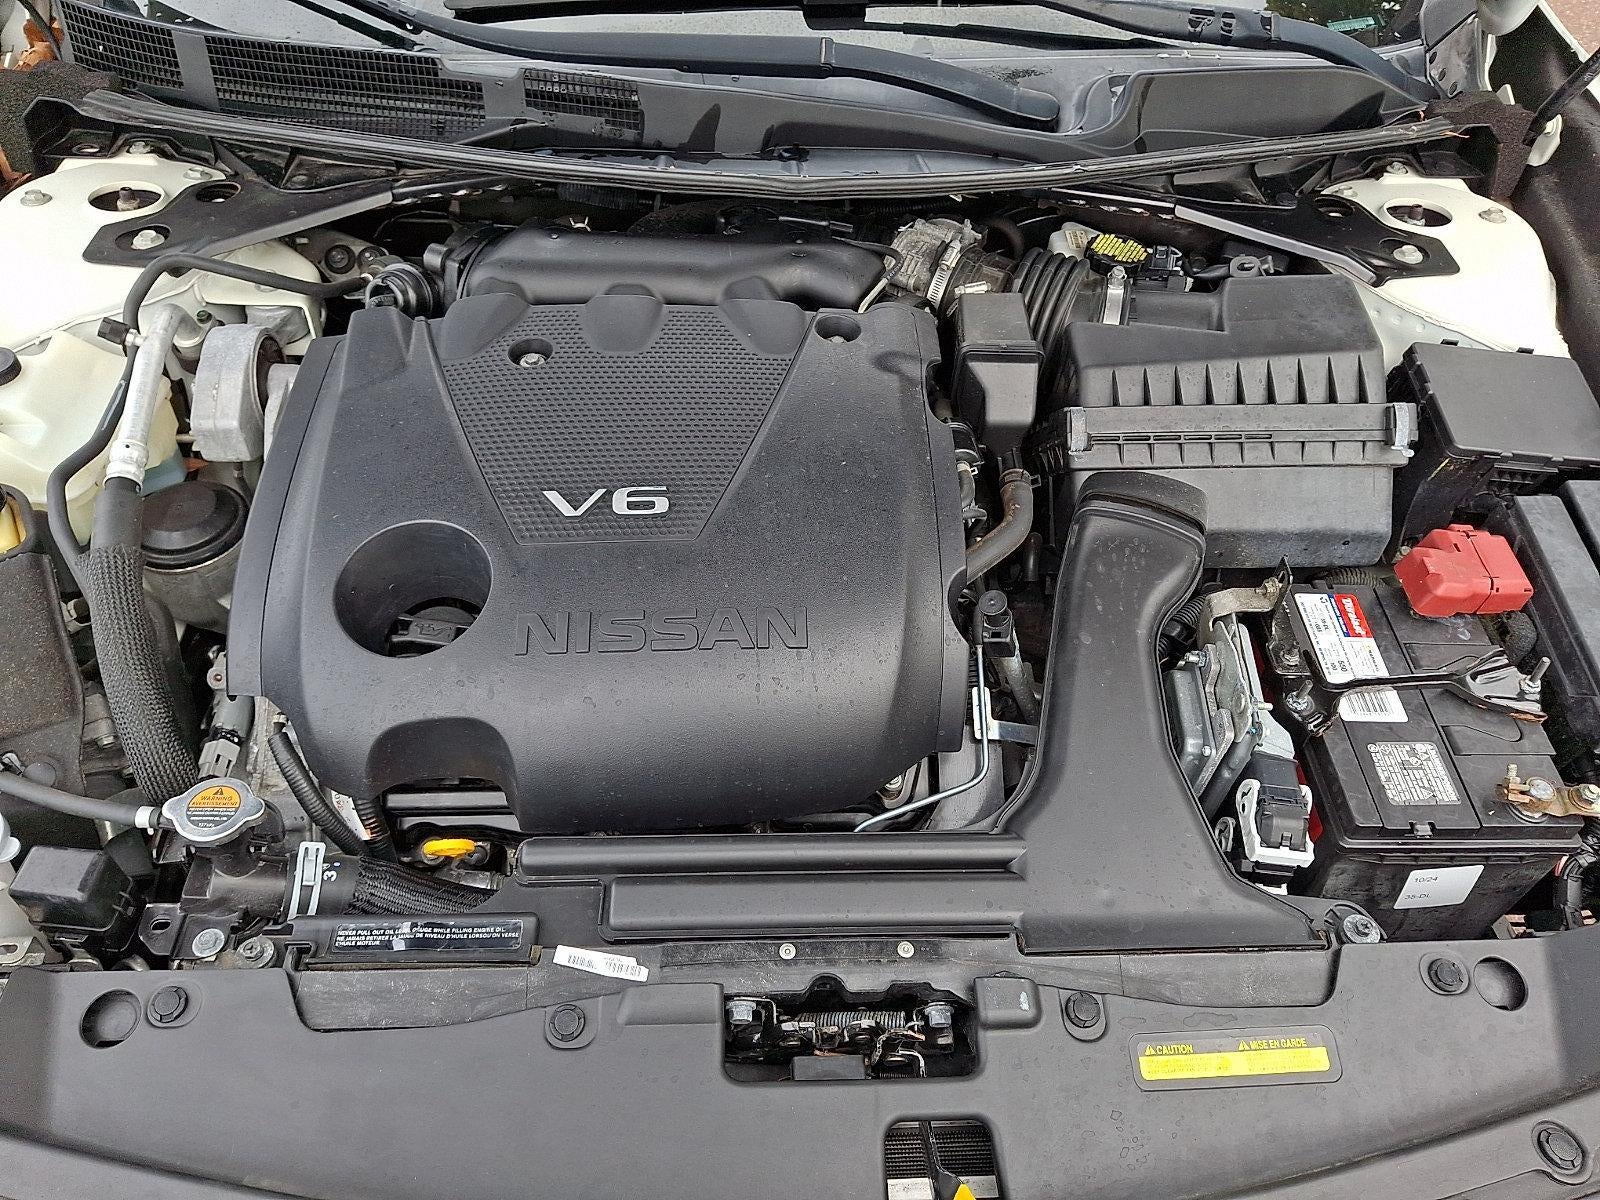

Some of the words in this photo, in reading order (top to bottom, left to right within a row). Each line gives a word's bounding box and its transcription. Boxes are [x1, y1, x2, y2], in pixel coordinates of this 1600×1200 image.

[542, 485, 670, 517] V6
[514, 606, 809, 656] NISSAN
[1156, 1044, 1194, 1054] CAUTION
[1249, 1039, 1267, 1050] MISE
[1268, 1038, 1280, 1049] EN
[1281, 1037, 1307, 1048] GARDE
